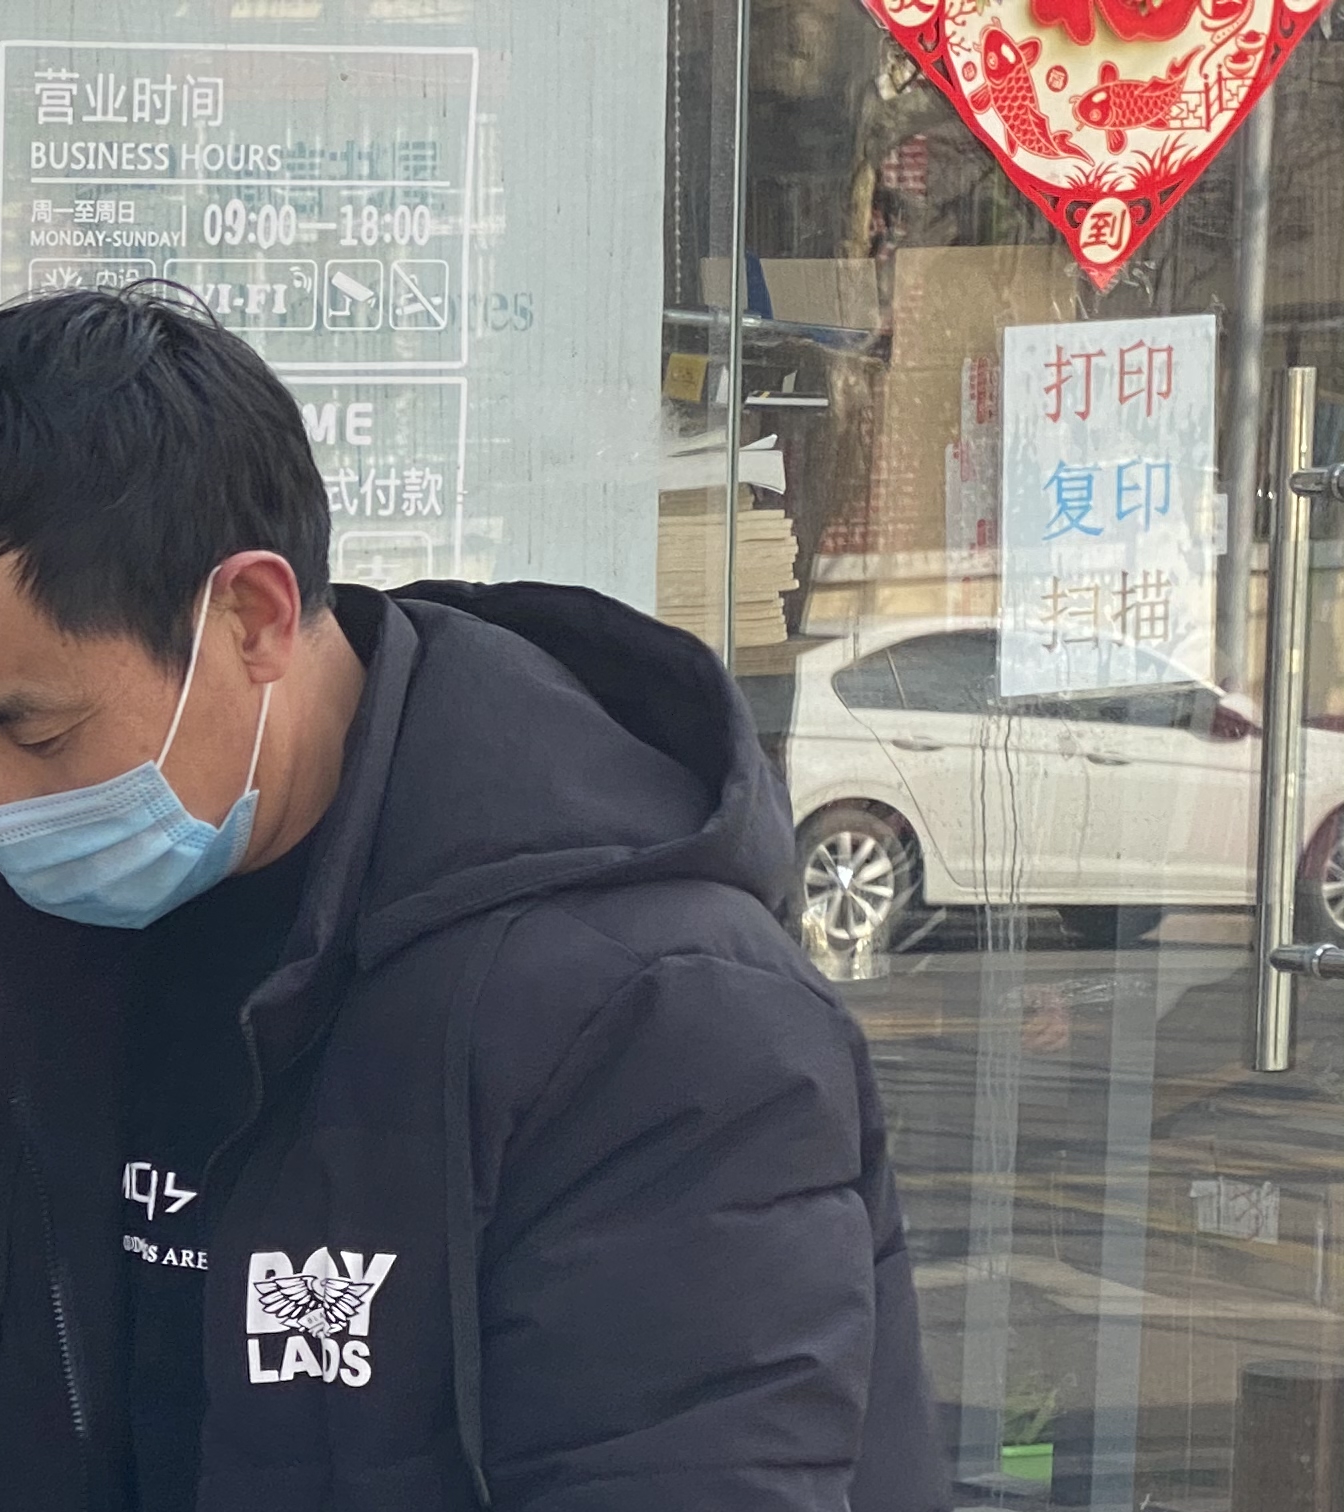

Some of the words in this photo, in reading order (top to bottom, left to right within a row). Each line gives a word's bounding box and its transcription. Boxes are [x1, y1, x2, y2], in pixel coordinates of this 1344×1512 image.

[33, 68, 223, 127] 营业时间
[30, 142, 169, 171] BUSINESS
[181, 144, 282, 172] HOURS
[30, 200, 135, 223] 周一至周日
[1081, 210, 1126, 250] 到
[30, 231, 182, 248] MONDAY-SUNDAY
[1043, 340, 1174, 423] 打印
[1042, 455, 1171, 541] 复印
[1040, 569, 1171, 653] 扫描
[161, 1247, 208, 1270] ARE
